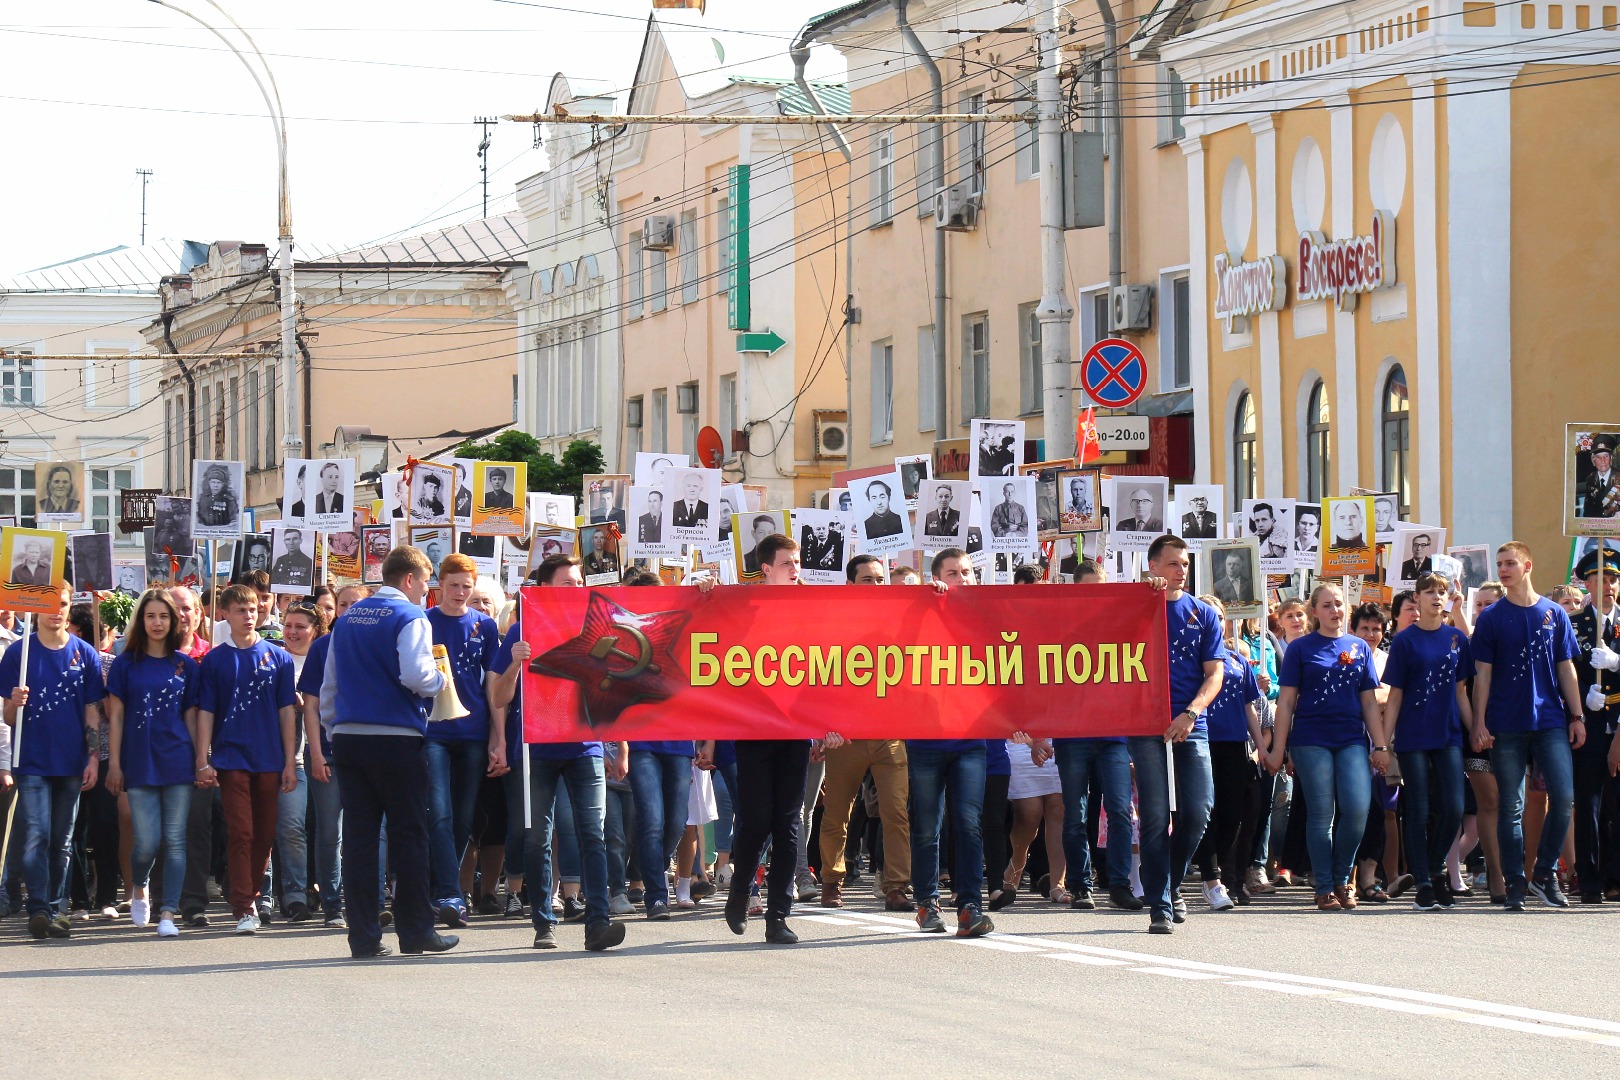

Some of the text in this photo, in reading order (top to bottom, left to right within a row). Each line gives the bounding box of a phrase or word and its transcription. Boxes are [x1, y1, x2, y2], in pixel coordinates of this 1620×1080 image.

[1216, 216, 1380, 327] Христос Воскресе!
[344, 606, 393, 617] ВОЛОНТЁР
[346, 616, 380, 626] ПОБЕДЫ
[690, 631, 1149, 698] Бессмертный полк
